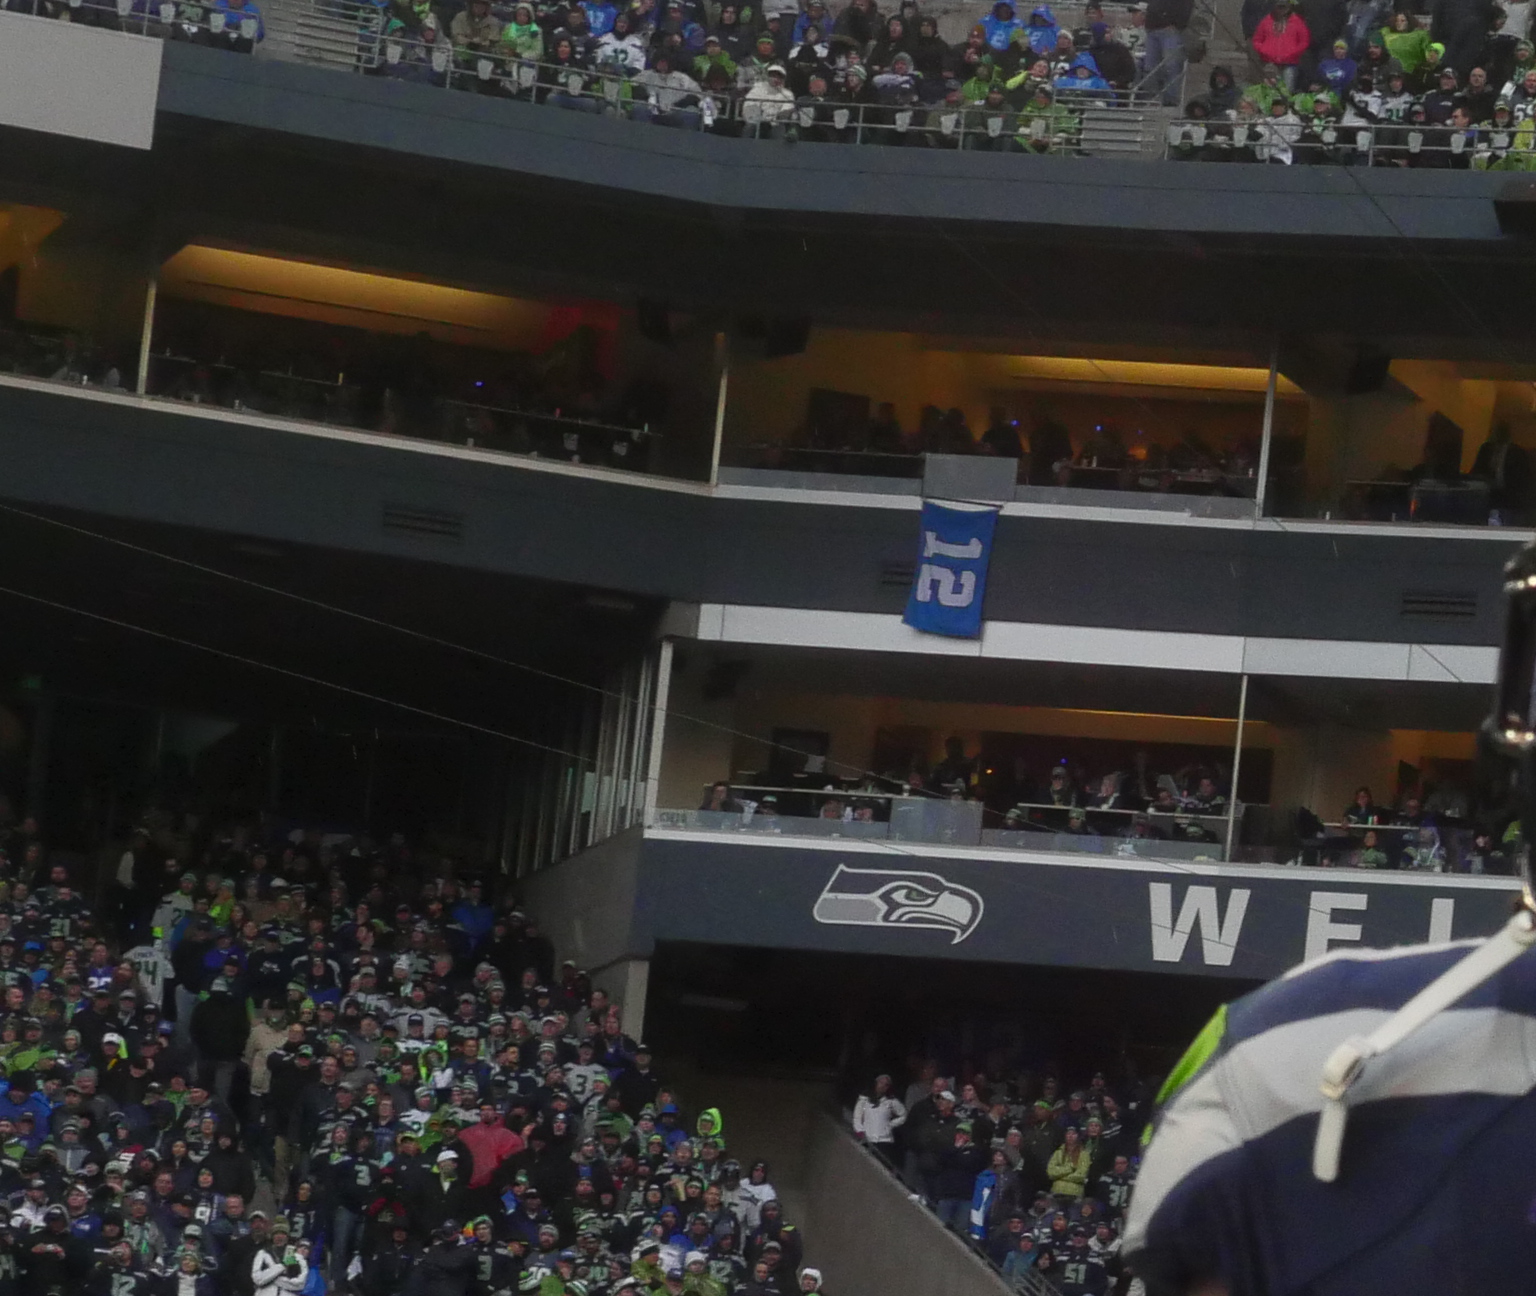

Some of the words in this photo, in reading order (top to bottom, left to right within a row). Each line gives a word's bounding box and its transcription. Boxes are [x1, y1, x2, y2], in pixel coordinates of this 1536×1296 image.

[916, 530, 983, 608] 12
[575, 1072, 591, 1096] 3
[354, 1164, 371, 1186] 3
[477, 1255, 493, 1281] 3
[1064, 1263, 1088, 1284] 51
